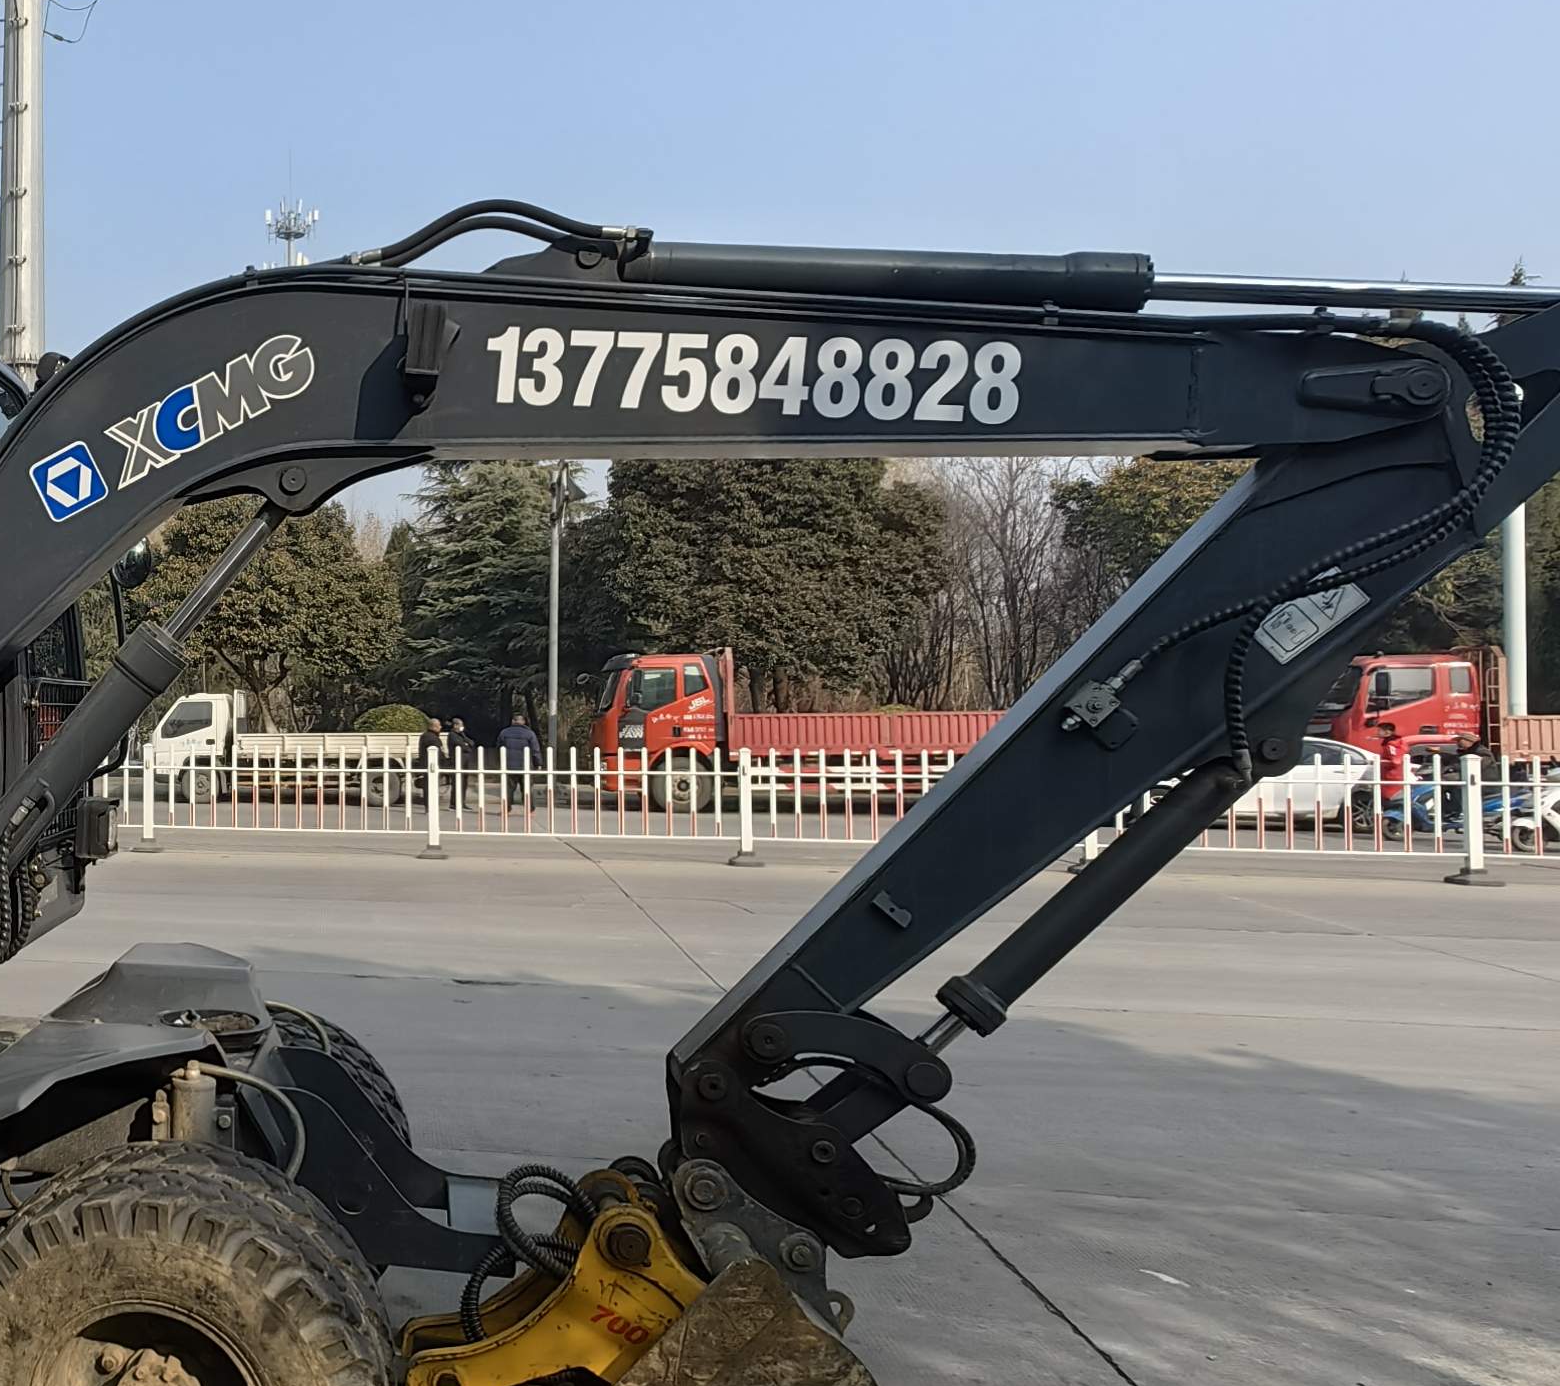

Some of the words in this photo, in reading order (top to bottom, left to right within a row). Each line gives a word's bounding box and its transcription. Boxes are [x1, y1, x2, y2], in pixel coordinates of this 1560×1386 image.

[104, 334, 315, 490] XCMG
[487, 326, 1021, 424] 13775848828
[590, 1304, 649, 1344] 700
